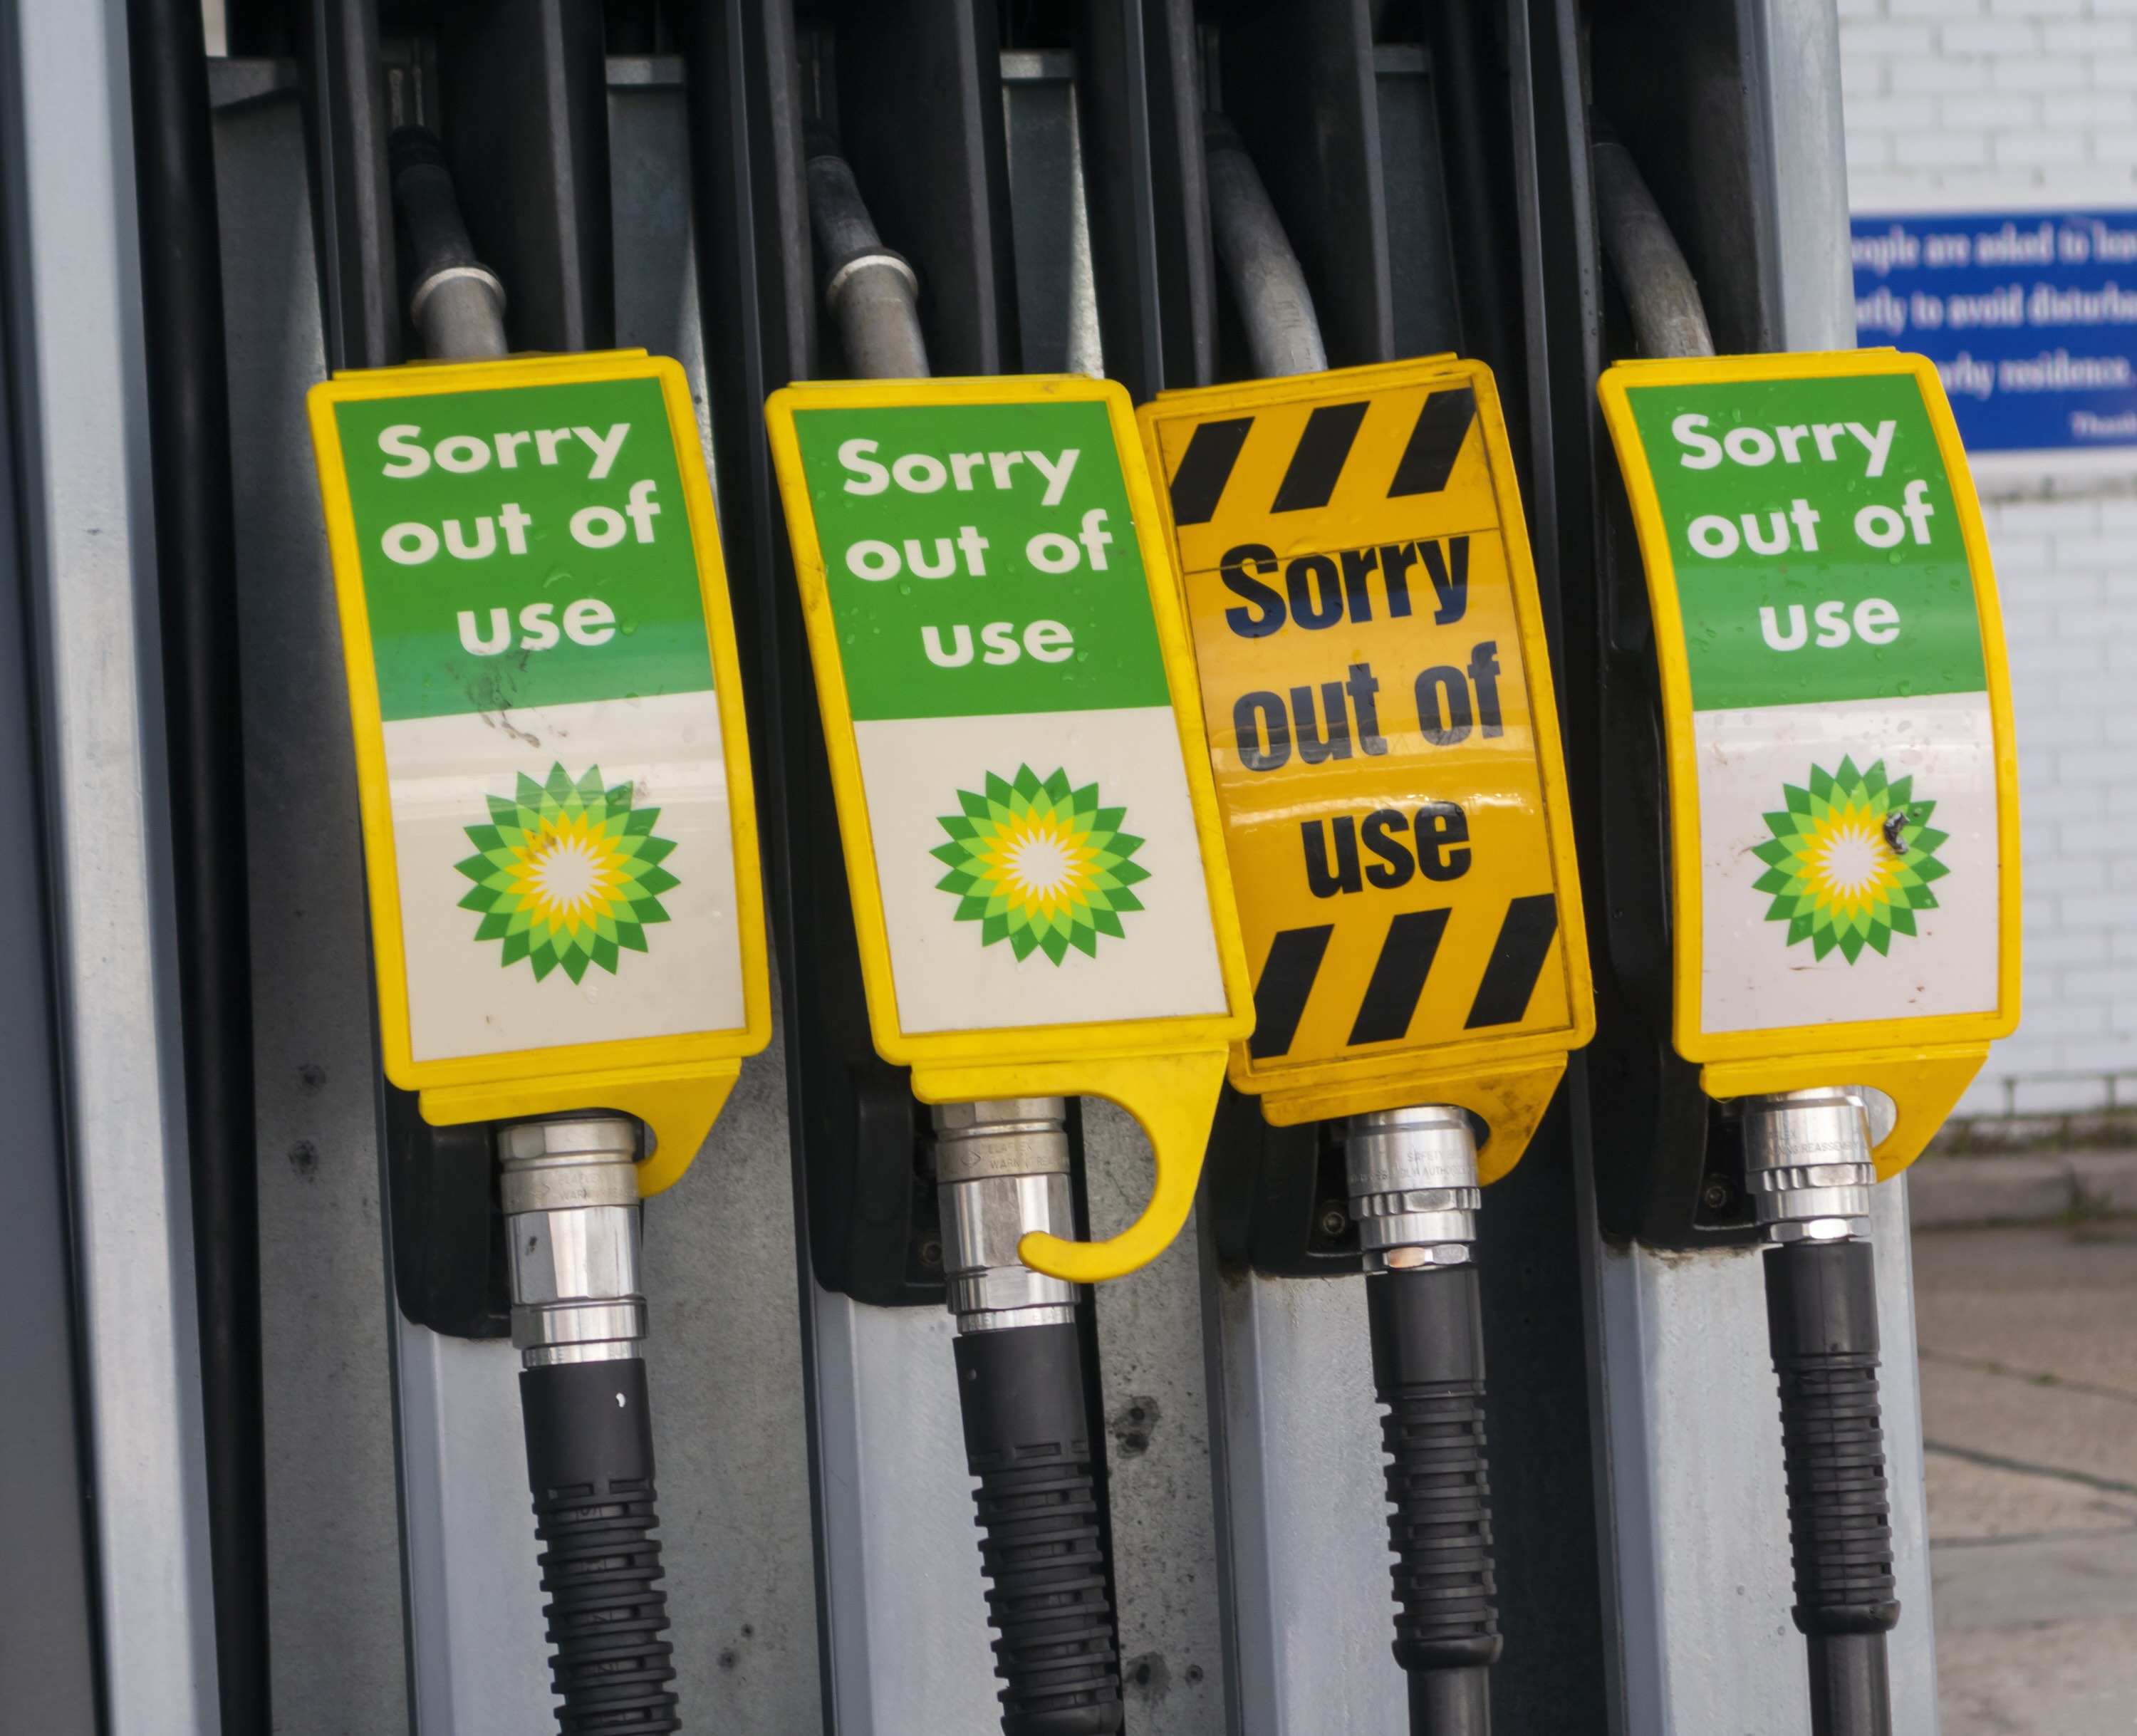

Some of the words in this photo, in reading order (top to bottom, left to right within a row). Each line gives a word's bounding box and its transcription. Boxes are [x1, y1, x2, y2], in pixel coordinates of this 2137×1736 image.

[1925, 234, 1970, 267] are
[1975, 222, 2054, 266] asked
[2058, 225, 2091, 264] to
[1911, 290, 1943, 330] to
[1947, 284, 2024, 328] avoid
[378, 423, 630, 479] Sorry
[838, 439, 1080, 506] Sorry
[1671, 413, 1897, 477] Sorry
[381, 503, 531, 565] out
[569, 479, 661, 549] of
[846, 526, 989, 581] out
[1026, 509, 1113, 574] of
[1687, 499, 1821, 559] out
[1853, 479, 1935, 549] of
[1220, 535, 1470, 639] Sorry
[457, 598, 616, 656] use
[921, 620, 1074, 667] use
[1758, 598, 1901, 652] use
[1232, 662, 1388, 771] out
[1414, 640, 1504, 747] of
[1300, 801, 1472, 899] use
